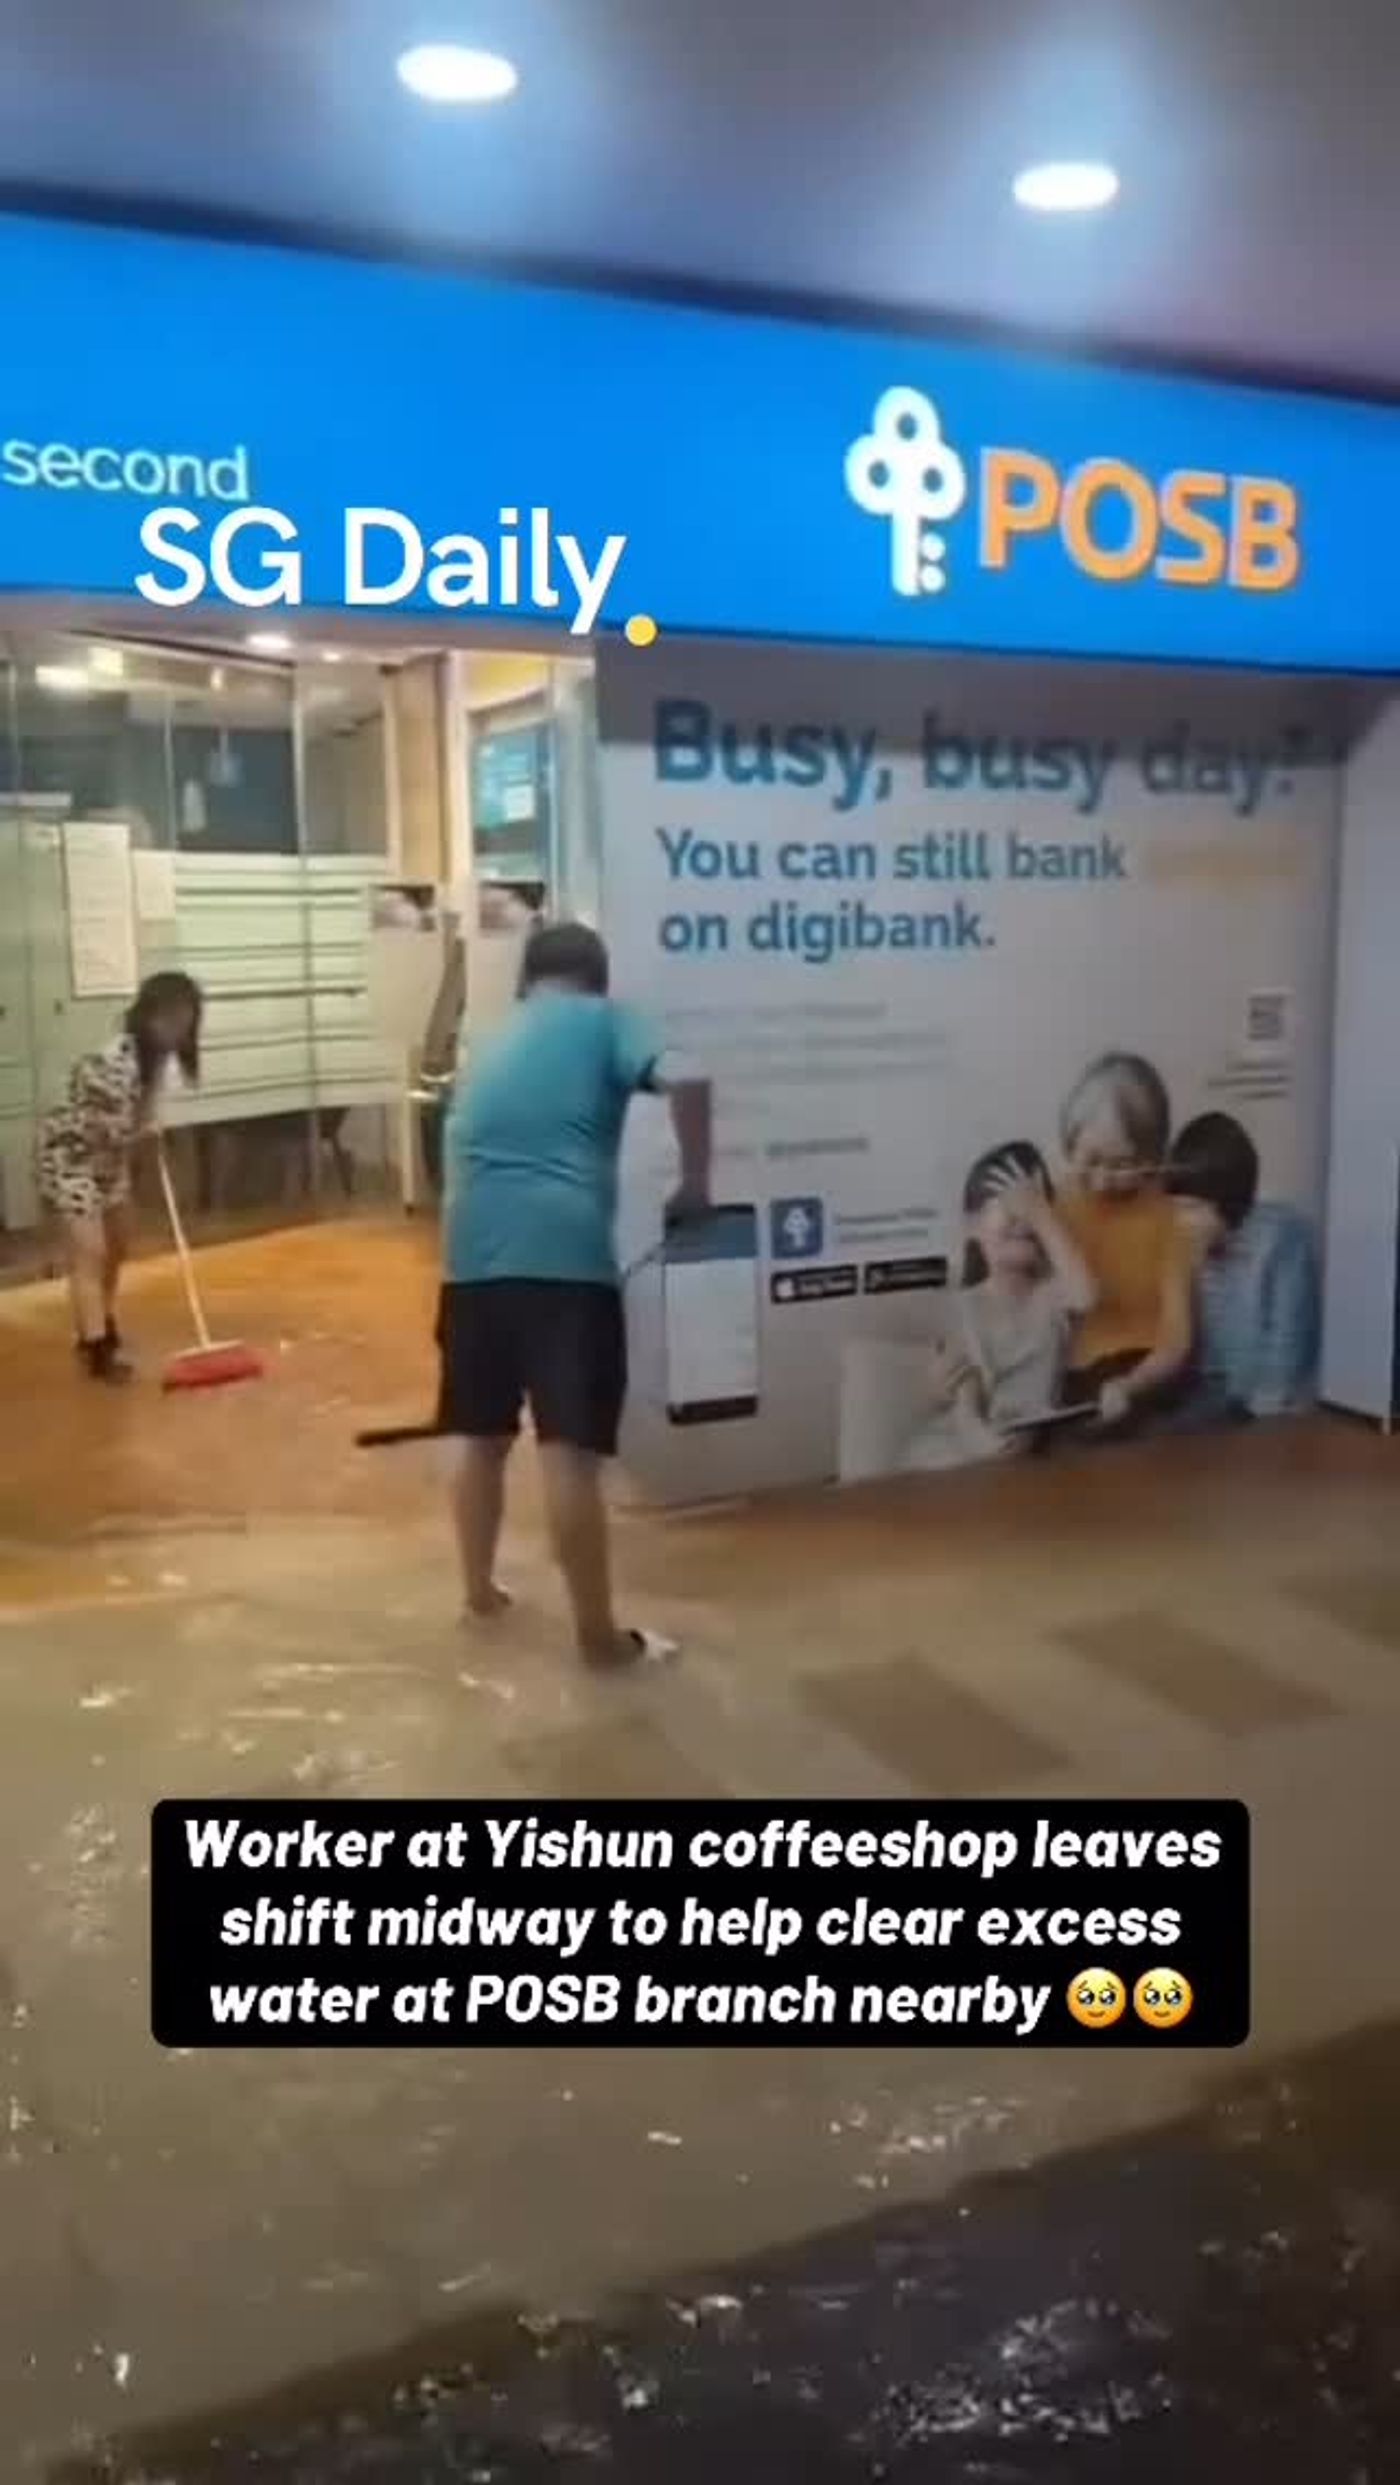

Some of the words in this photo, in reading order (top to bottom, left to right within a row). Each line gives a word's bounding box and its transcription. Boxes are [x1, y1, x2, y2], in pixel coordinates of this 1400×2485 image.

[2, 438, 249, 500] second
[980, 446, 1299, 591] POSB
[655, 700, 892, 811] Busy,
[923, 712, 1117, 814] busy
[656, 828, 759, 880] You
[777, 839, 876, 880] can
[893, 829, 993, 880] still
[1007, 832, 1129, 880] bank
[658, 912, 728, 951] on
[747, 902, 996, 962] digibank.
